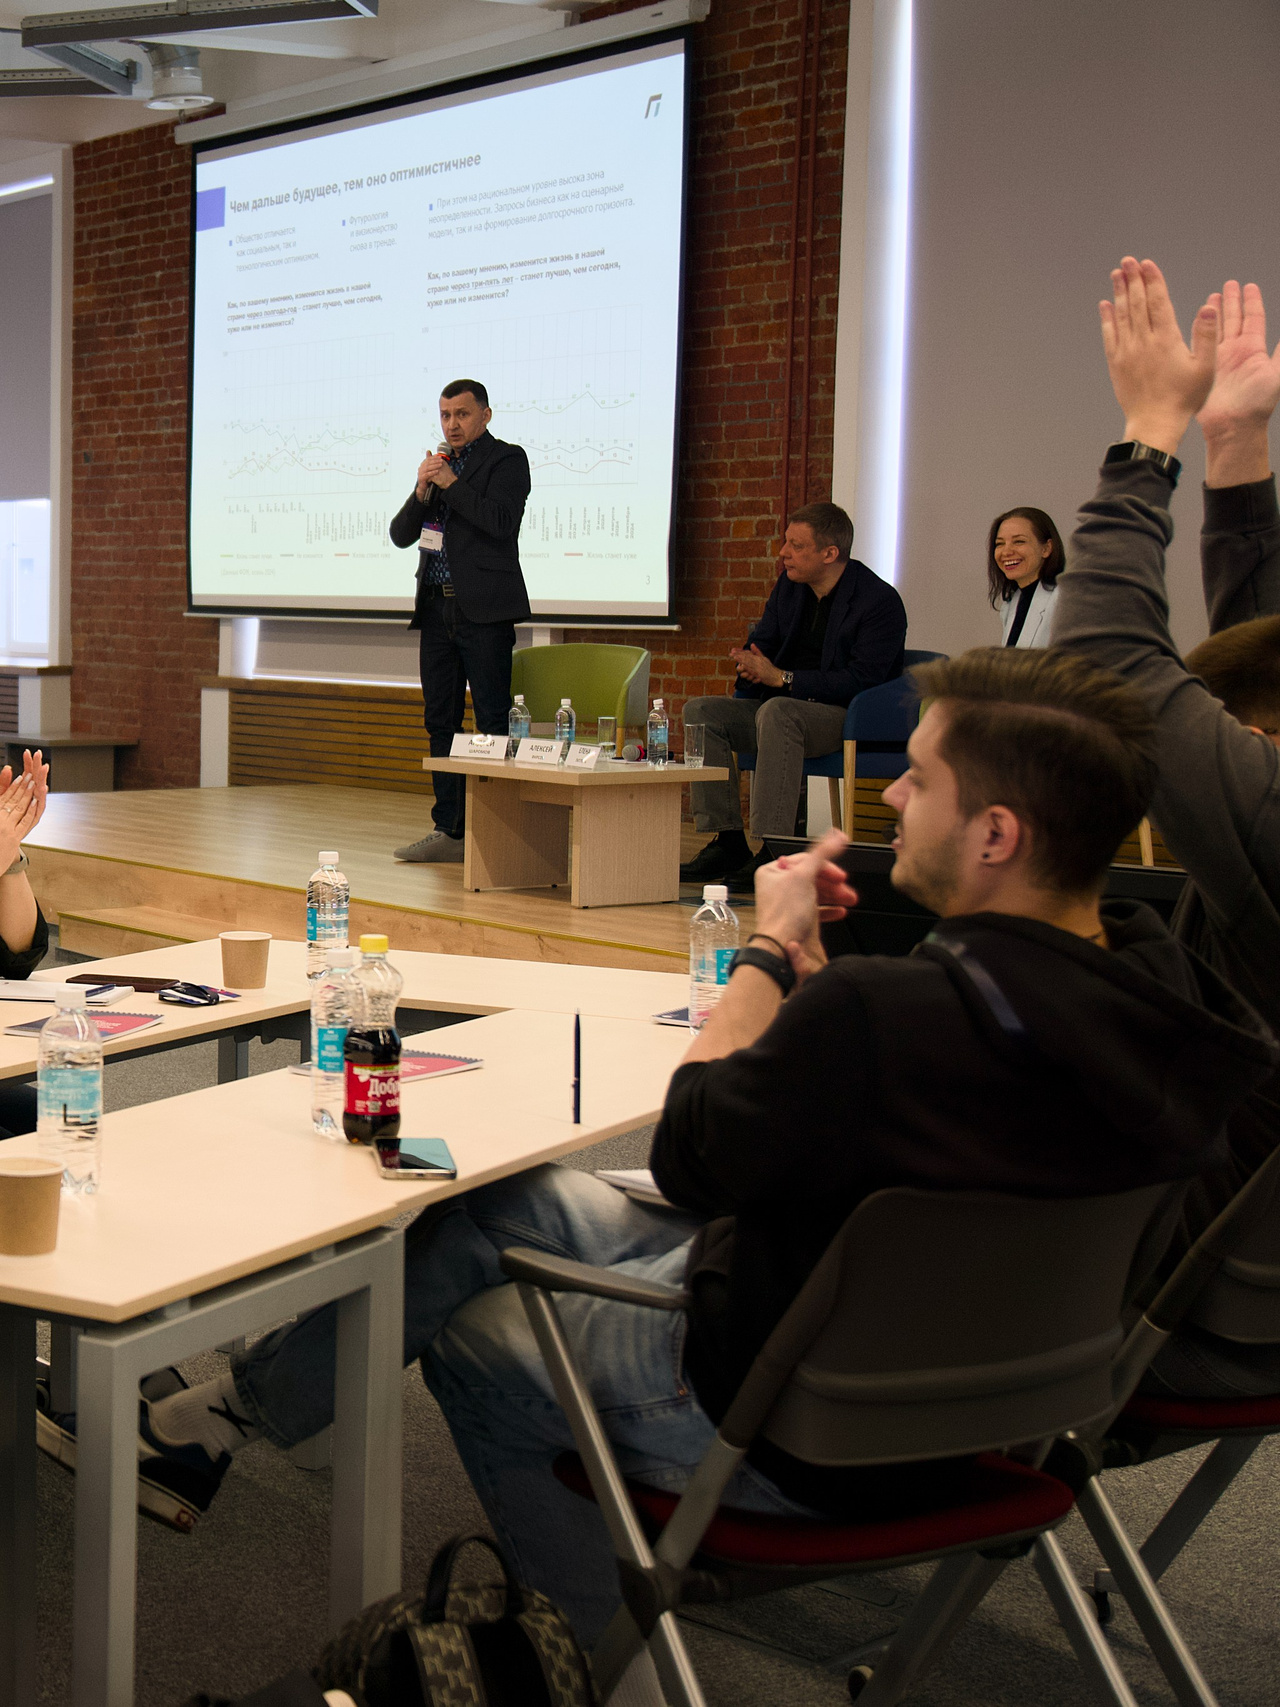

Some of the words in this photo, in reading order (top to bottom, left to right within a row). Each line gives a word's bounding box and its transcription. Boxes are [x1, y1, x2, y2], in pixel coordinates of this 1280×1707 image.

[230, 200, 250, 214] Чем
[251, 192, 290, 211] дальше
[293, 182, 341, 205] будущее,
[344, 178, 364, 193] тем
[367, 173, 387, 187] оно
[390, 152, 482, 182] оптимистичнее
[436, 197, 451, 209] При
[452, 195, 468, 206] этом
[468, 193, 477, 203] на
[478, 183, 530, 205] рациональном
[531, 179, 557, 193] уровне
[559, 174, 585, 186] высока
[586, 170, 604, 182] зона
[428, 206, 493, 224] неопределенности.
[494, 199, 525, 215] Запросы
[526, 196, 556, 208] бизнеса
[557, 192, 570, 203] как
[571, 191, 580, 200] на
[582, 182, 624, 198] сценарные
[349, 211, 389, 225] Футурология
[428, 226, 454, 240] модели,
[456, 225, 466, 235] так
[468, 224, 472, 233] и
[473, 223, 482, 231] на
[484, 213, 537, 231] формирование
[538, 204, 594, 222] долгосрочного
[595, 197, 635, 213] горизонта.
[236, 232, 263, 244] Общество
[355, 223, 398, 238] визионерство
[350, 242, 367, 252] снова
[374, 237, 397, 250] тренде.
[428, 271, 440, 281] Как,
[442, 270, 450, 279] по
[452, 266, 478, 279] вашему
[479, 262, 509, 274] мнению,
[510, 255, 548, 269] изменится
[549, 253, 574, 264] жизнь
[581, 248, 605, 259] нашей
[427, 284, 450, 296] стране
[451, 282, 470, 293] через
[471, 277, 500, 291] три-пять
[501, 275, 514, 285] лет
[520, 271, 544, 282] станет
[545, 268, 572, 280] лучше,
[589, 261, 620, 274] сегодня,
[227, 300, 238, 310] Как,
[247, 297, 269, 308] вашему
[295, 289, 325, 301] изменится
[351, 281, 371, 292] нашей
[227, 312, 245, 321] стране
[247, 310, 262, 320] через
[263, 306, 297, 317] полгода-год
[302, 303, 320, 312] станет
[322, 300, 342, 310] лучше,
[356, 293, 383, 305] сегодня,
[427, 298, 443, 309] хуже
[444, 297, 457, 306] или
[458, 295, 466, 304] не
[468, 289, 509, 302] изменится?
[227, 325, 240, 334] хуже
[261, 318, 294, 329] изменится?
[645, 575, 651, 585] 3
[529, 745, 553, 753] АЛЕКСЕЙ
